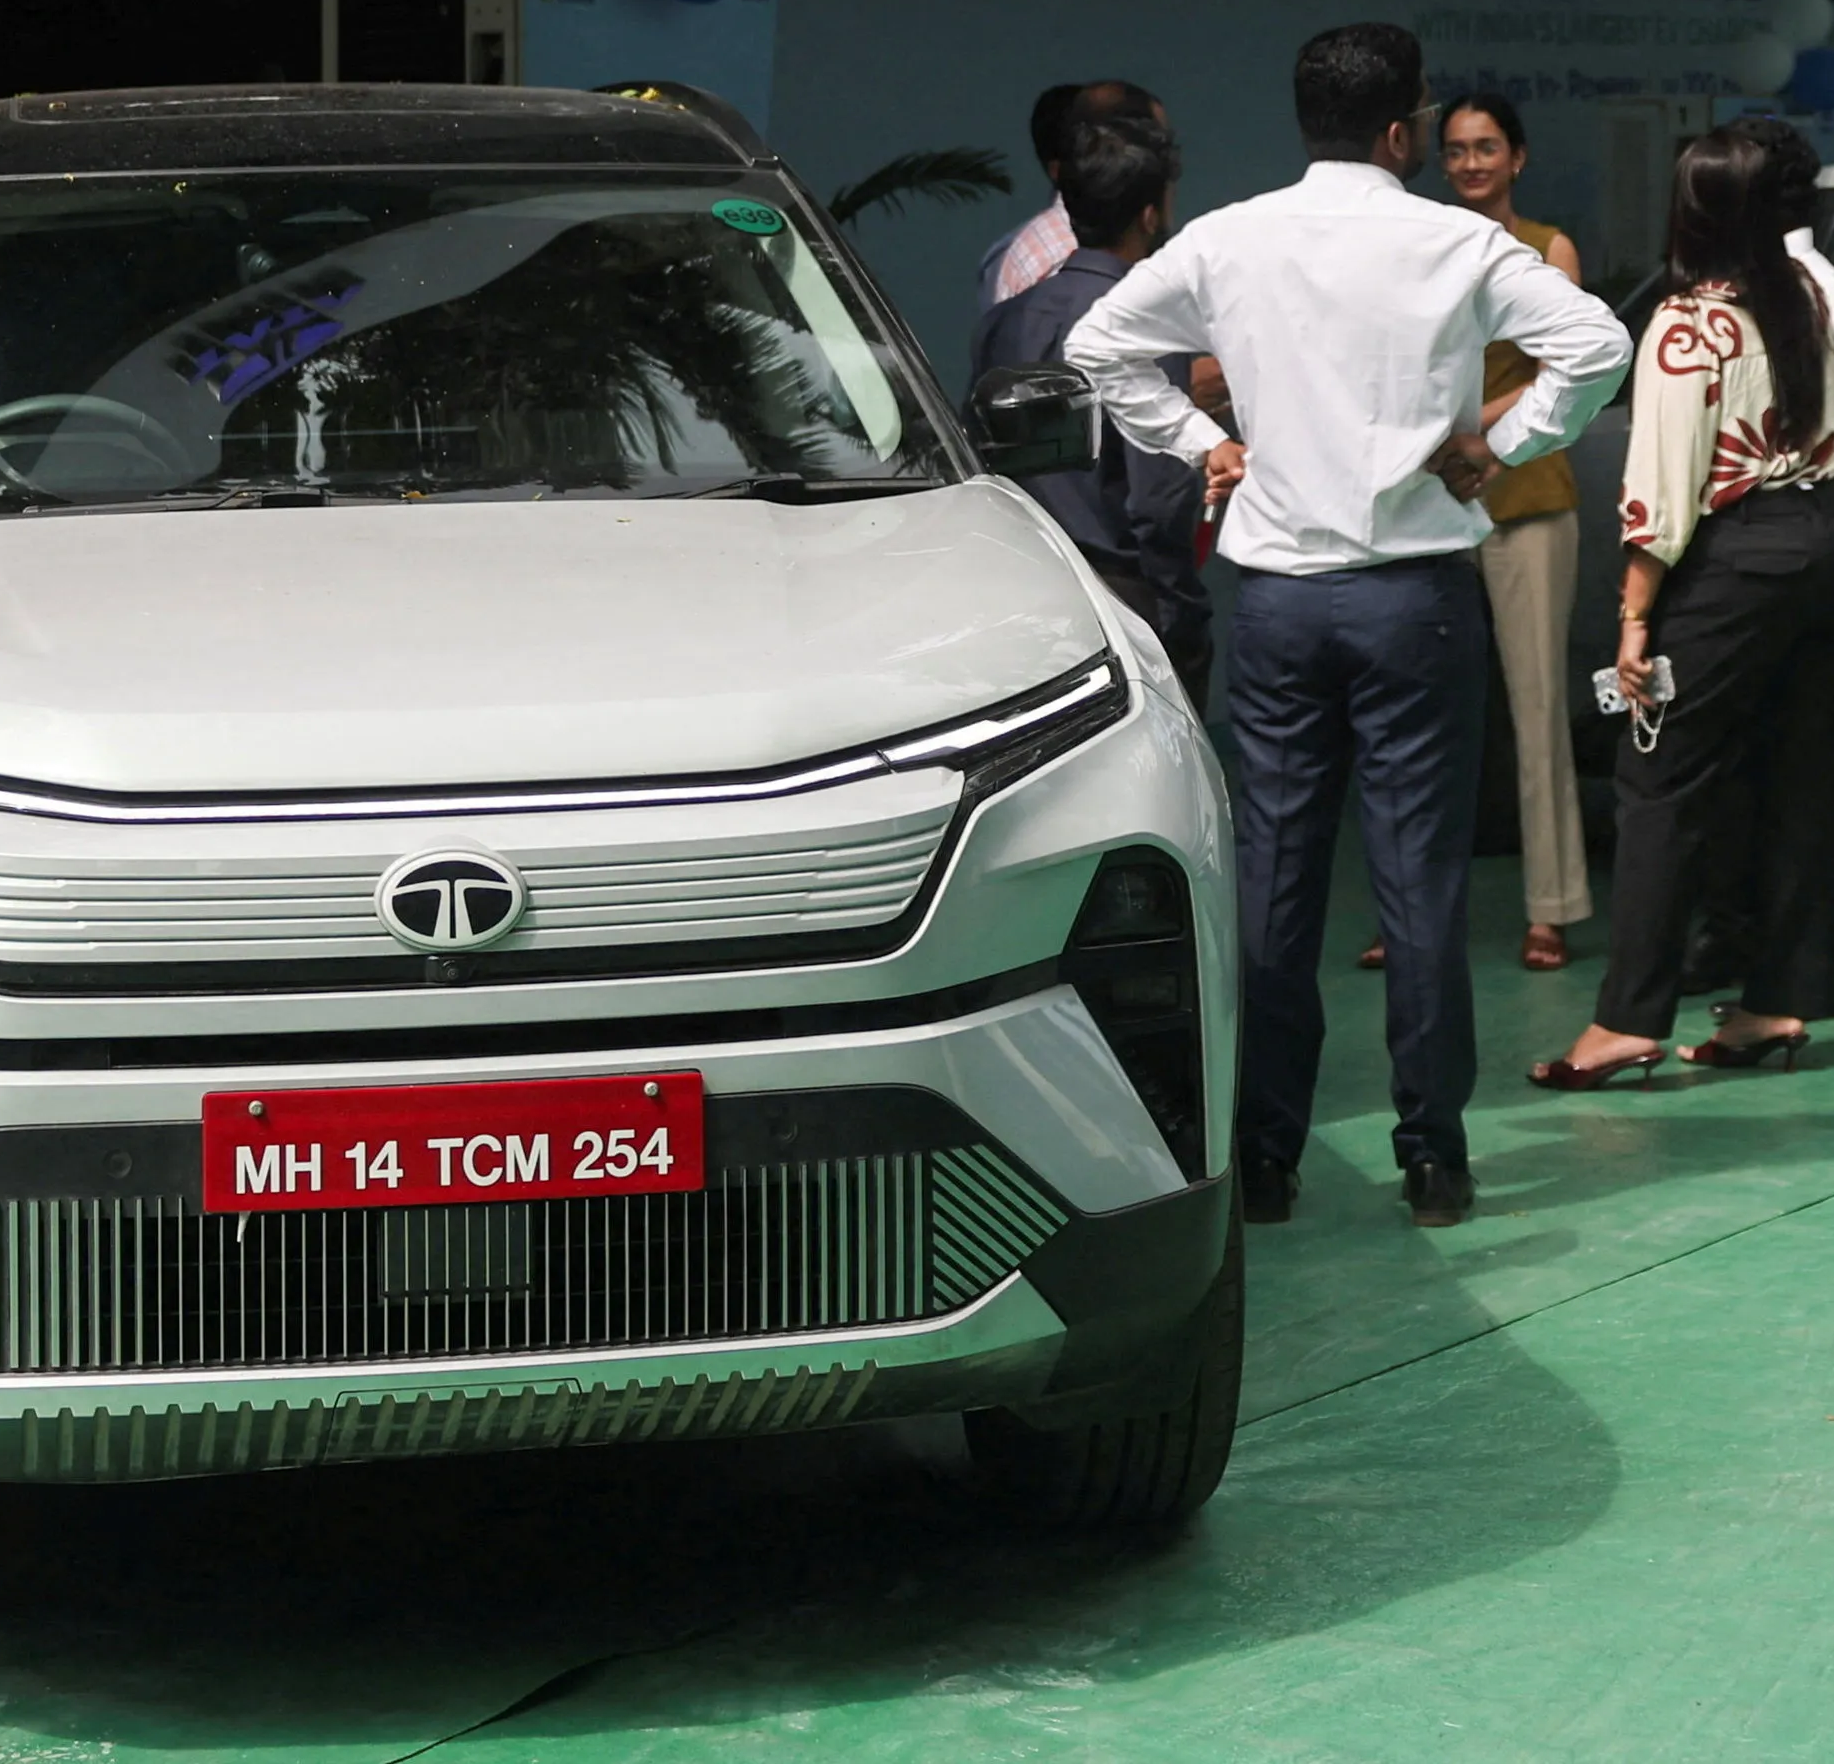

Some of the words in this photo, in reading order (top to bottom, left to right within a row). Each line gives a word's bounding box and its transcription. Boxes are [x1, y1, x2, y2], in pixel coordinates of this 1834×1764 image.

[235, 1143, 322, 1195] MH
[344, 1140, 405, 1190] 14
[426, 1132, 551, 1187] TCM
[572, 1126, 674, 1180] 254
